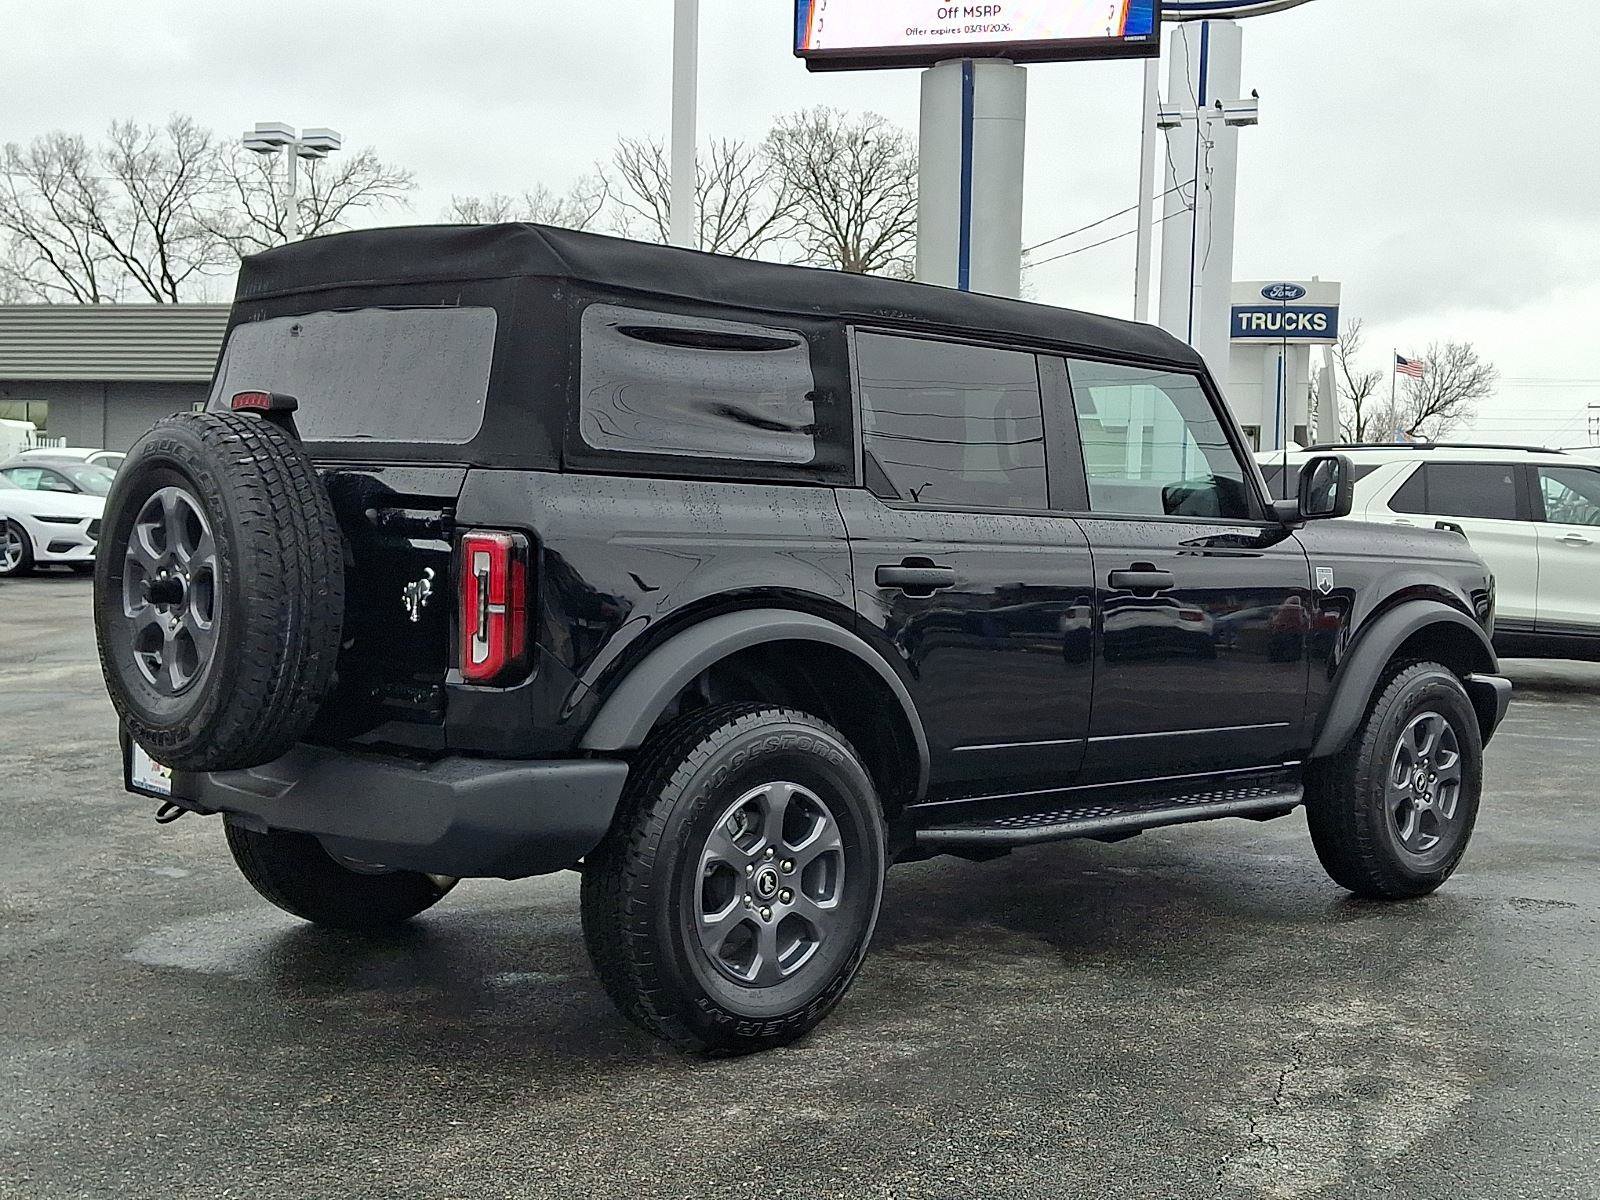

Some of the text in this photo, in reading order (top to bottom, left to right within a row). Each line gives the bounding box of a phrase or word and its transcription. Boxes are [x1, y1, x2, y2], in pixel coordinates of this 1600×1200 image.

[937, 4, 1002, 20] Off MSRP
[905, 27, 927, 36] Offer
[930, 26, 962, 36] expires
[1269, 284, 1298, 298] Ford
[1237, 311, 1328, 331] TRUCKS
